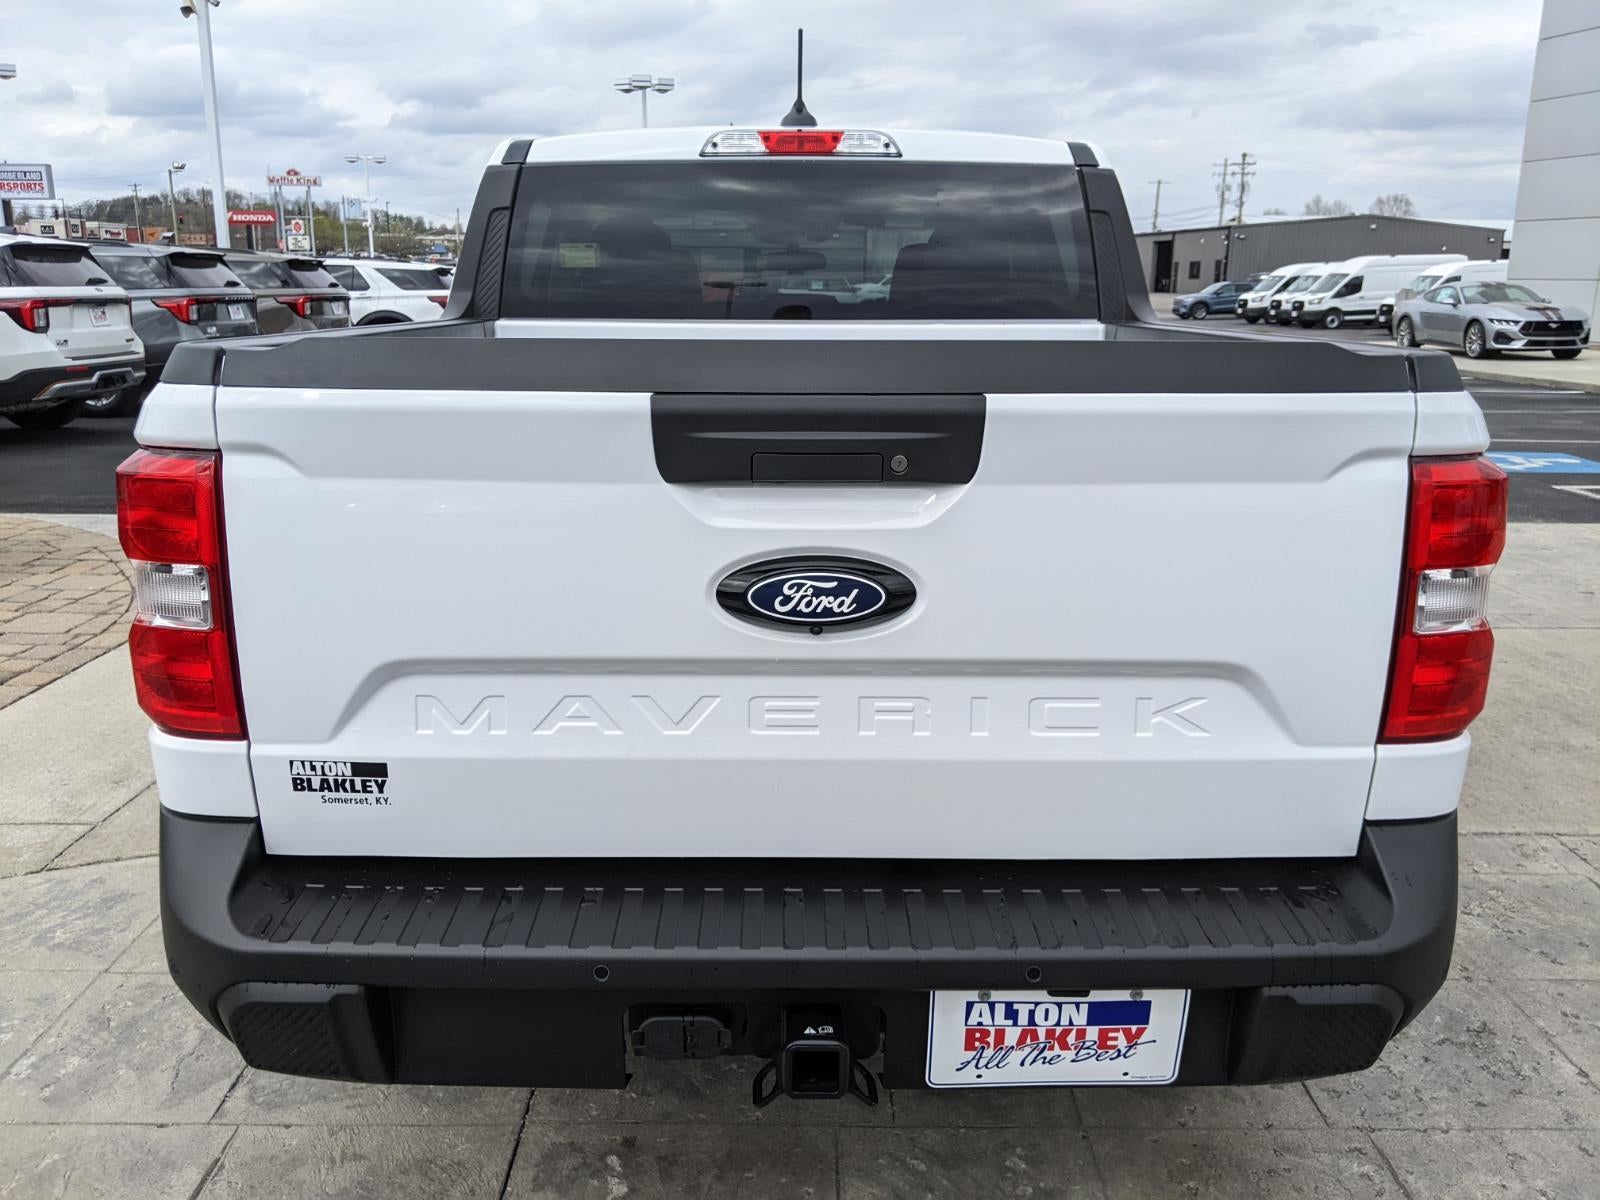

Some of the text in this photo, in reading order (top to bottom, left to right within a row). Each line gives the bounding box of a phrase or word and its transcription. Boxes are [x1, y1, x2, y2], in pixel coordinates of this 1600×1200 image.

[232, 214, 275, 222] HONDA
[774, 579, 858, 613] Ford
[415, 694, 1211, 737] MAVERICK
[291, 761, 352, 777] ALTON
[291, 777, 387, 794] BLAKLEY
[321, 795, 392, 806] Somerset, KY.
[966, 1003, 1089, 1026] ALTON
[964, 1027, 1148, 1052] BLAKLEY
[955, 1039, 1157, 1072] All The Best
